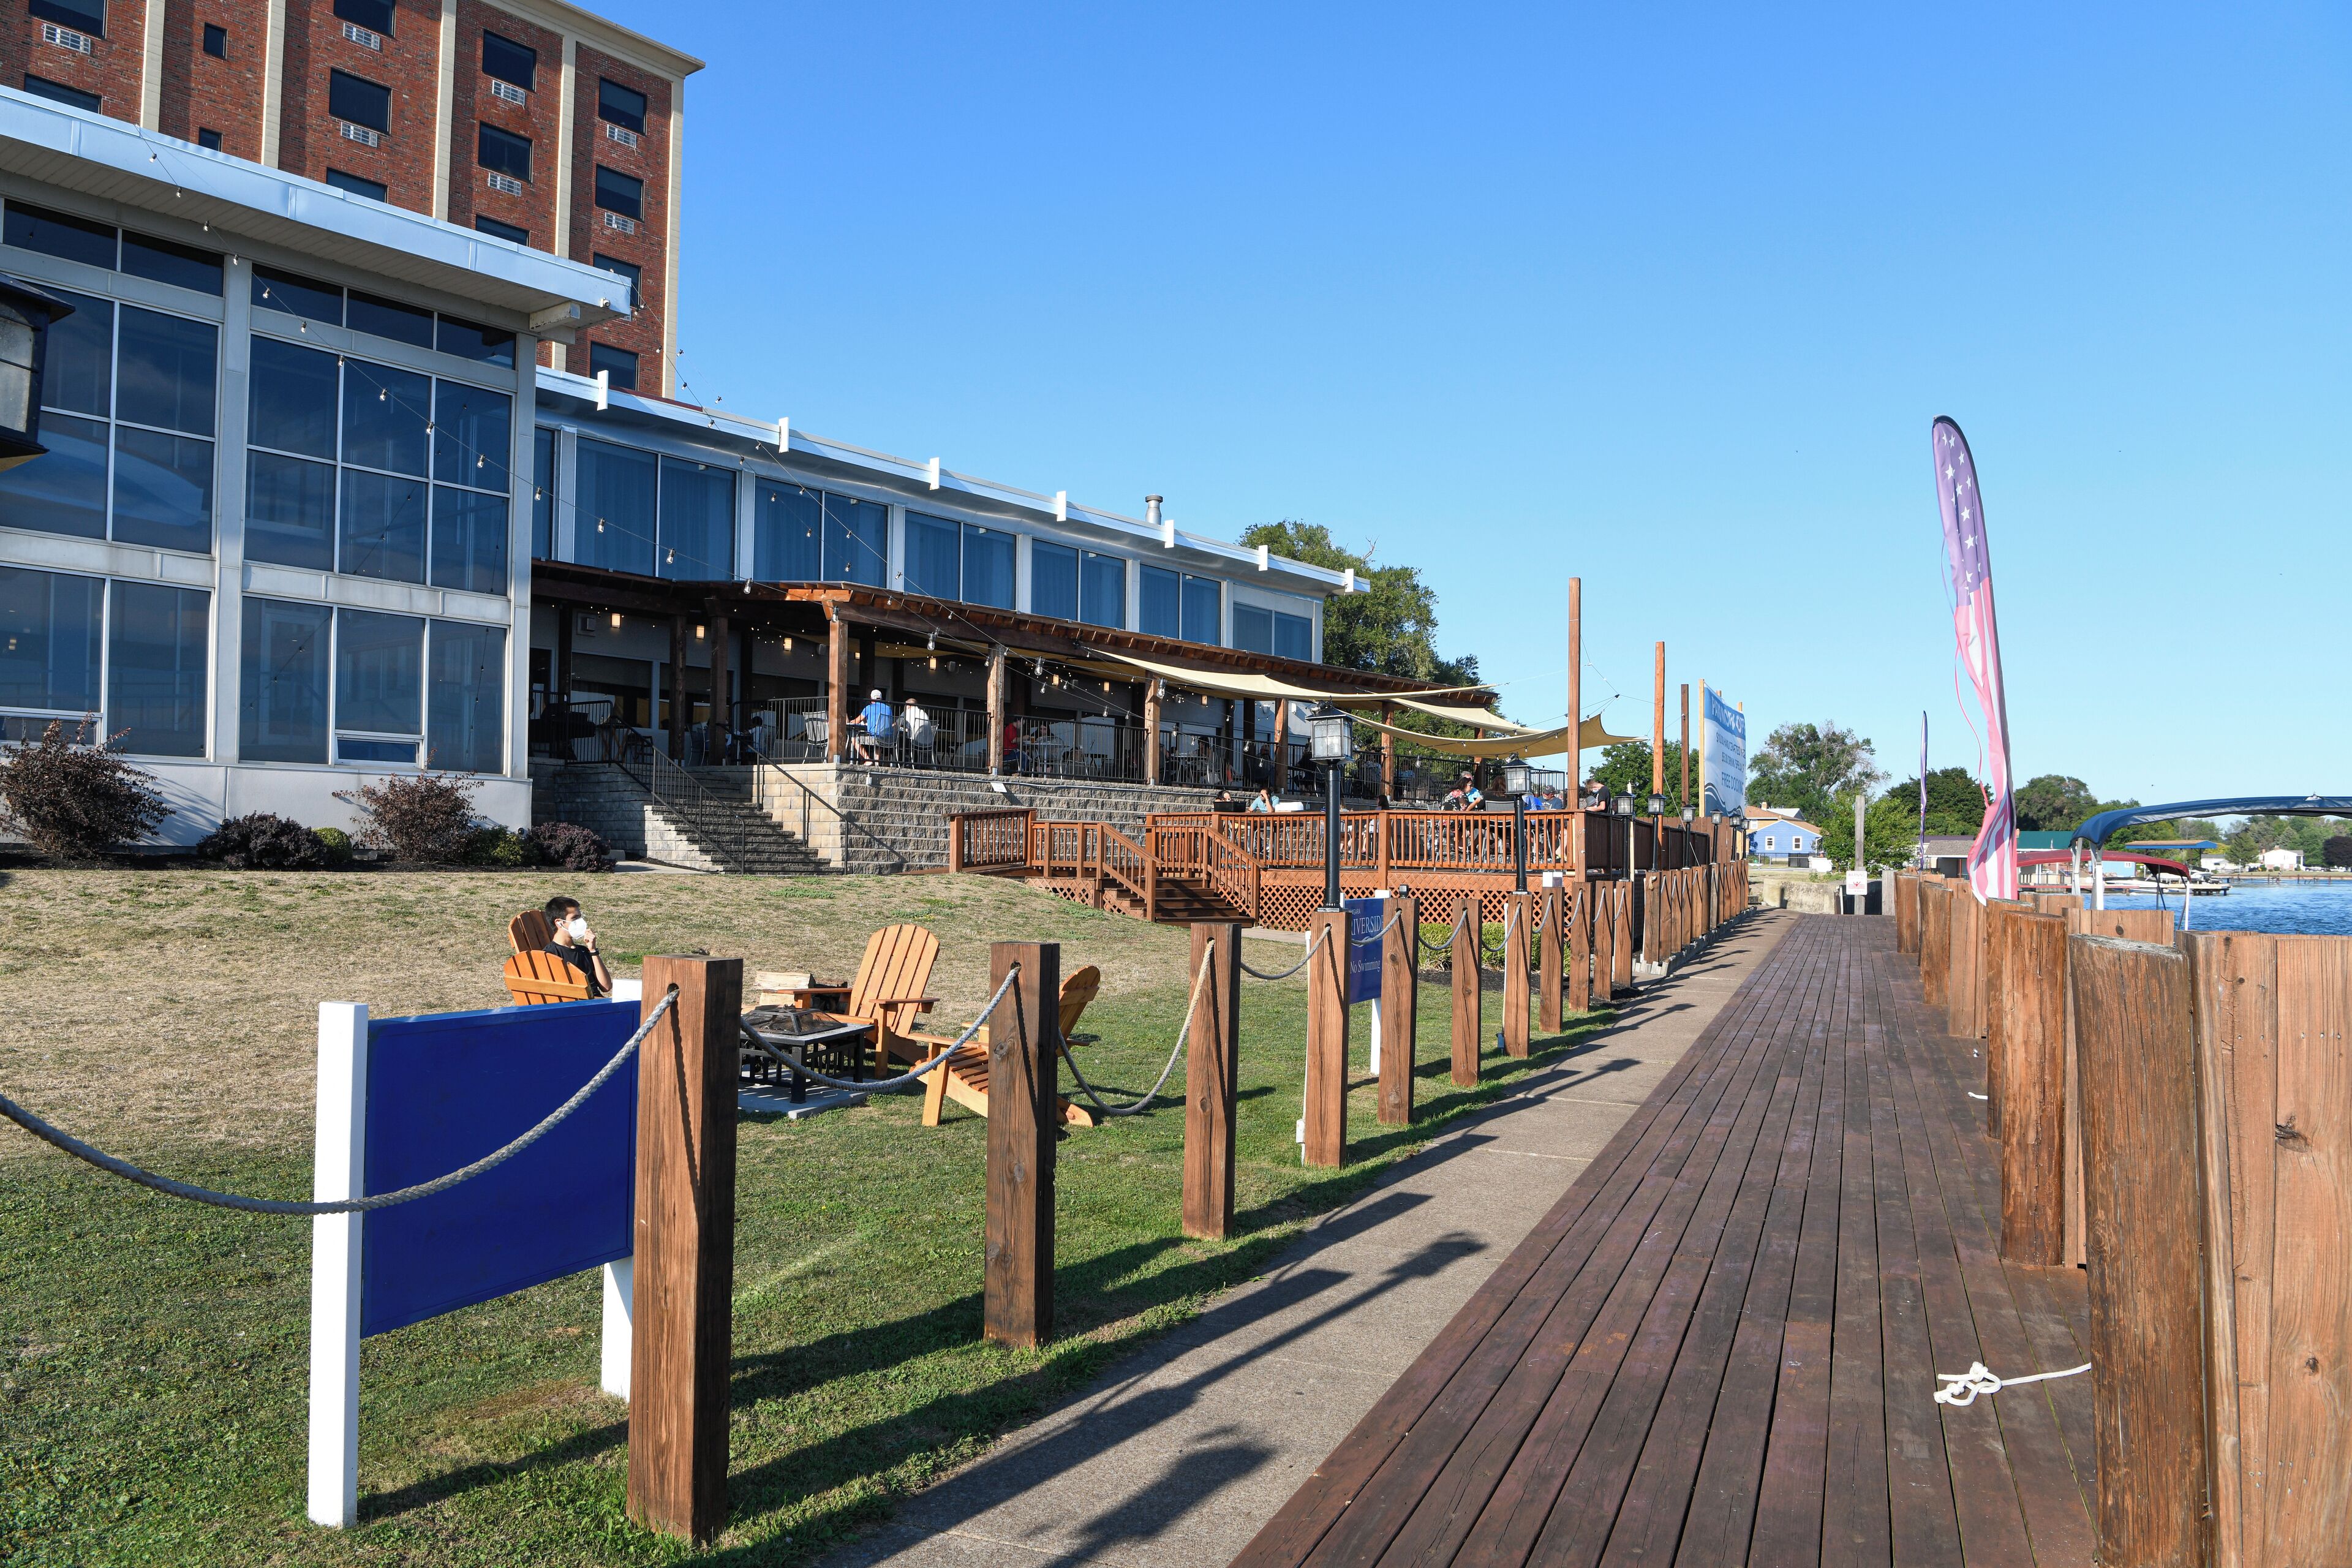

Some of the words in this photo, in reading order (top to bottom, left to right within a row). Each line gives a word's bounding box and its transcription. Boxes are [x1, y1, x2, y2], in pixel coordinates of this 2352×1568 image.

[1722, 771, 1731, 789] FREE
[1351, 960, 1357, 974] No
[1358, 957, 1381, 973] Swimming
